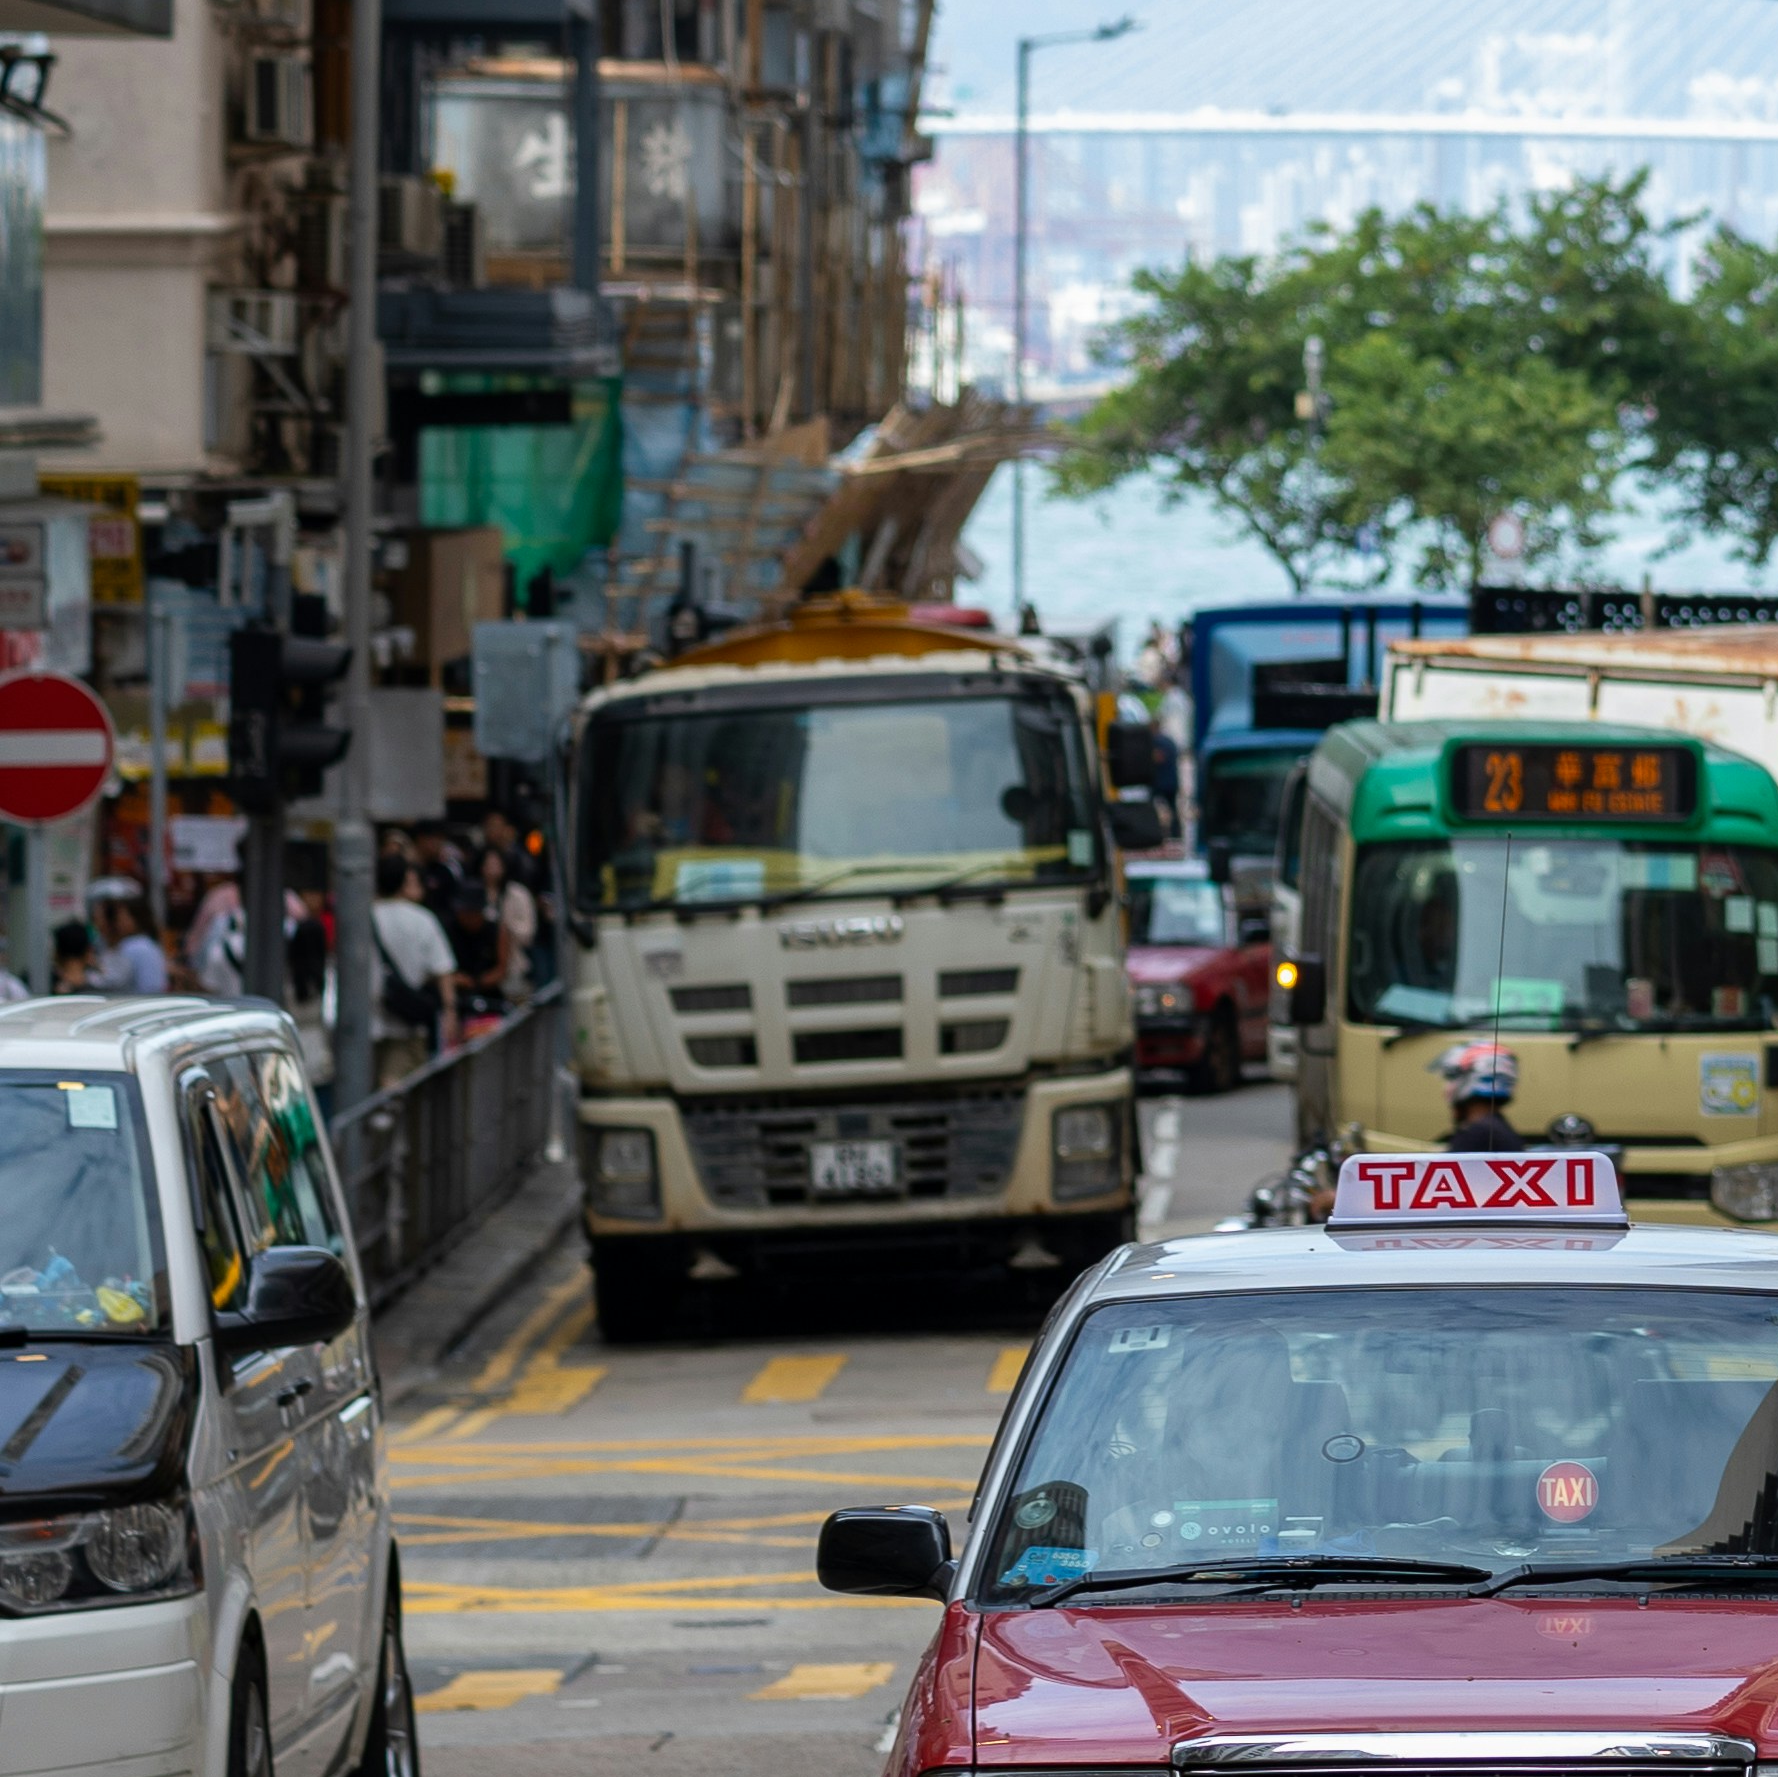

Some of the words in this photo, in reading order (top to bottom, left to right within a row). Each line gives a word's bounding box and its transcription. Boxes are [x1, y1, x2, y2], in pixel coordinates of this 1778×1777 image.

[1484, 752, 1523, 813] 23
[1358, 1159, 1595, 1210] TAXI
[1542, 1477, 1593, 1507] TAXI
[1208, 1524, 1270, 1535] ovolo
